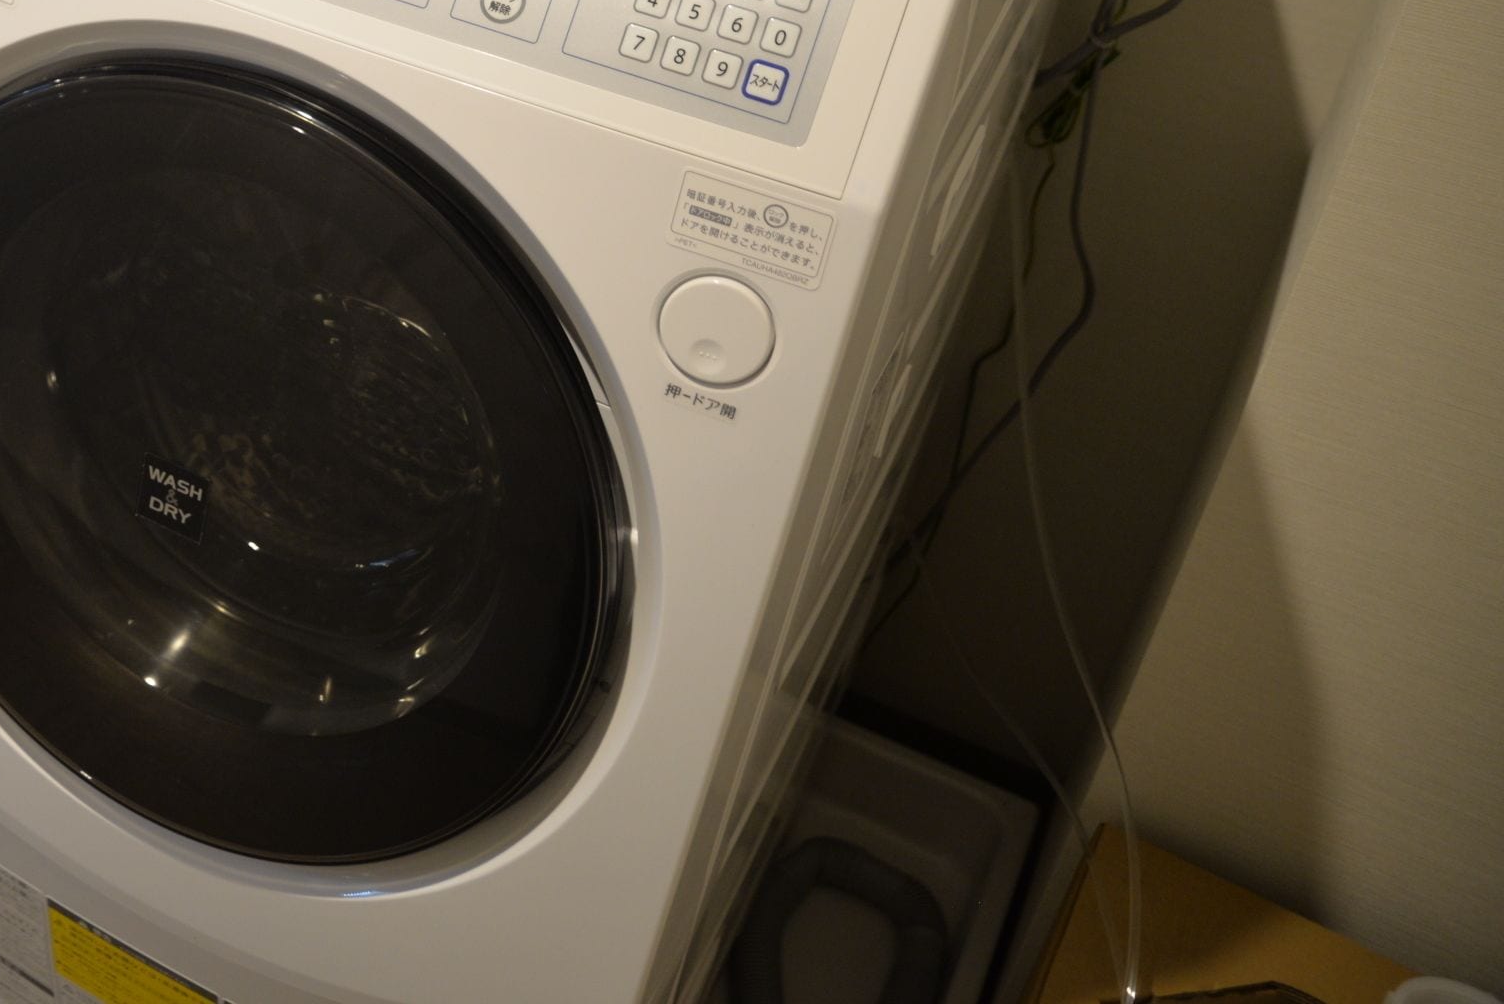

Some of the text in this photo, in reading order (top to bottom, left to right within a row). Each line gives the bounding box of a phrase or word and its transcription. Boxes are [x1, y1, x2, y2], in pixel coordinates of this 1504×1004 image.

[488, 0, 511, 16] 解除
[688, 4, 700, 20] 5
[731, 17, 743, 33] 6
[774, 29, 787, 46] 0
[633, 35, 780, 94] 7 8 9 スタート
[681, 218, 814, 270] ドアを開けることができます。
[149, 465, 203, 501] WASH
[166, 489, 178, 506] &
[149, 496, 192, 524] DRY
